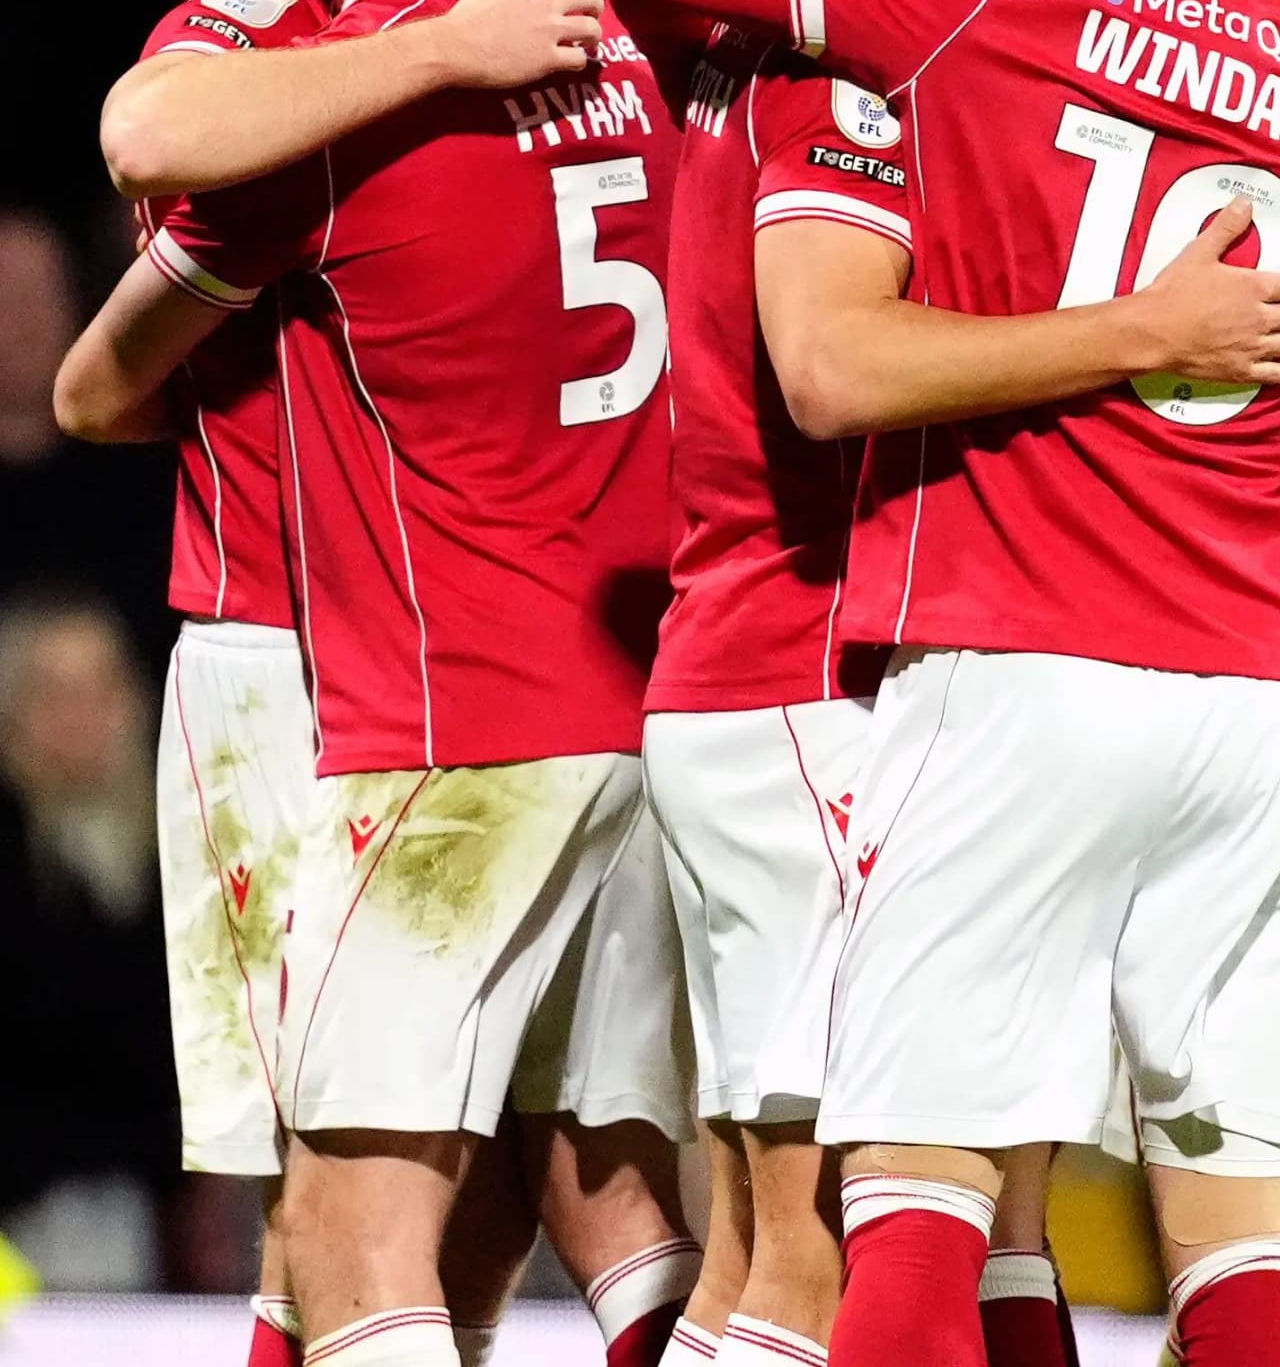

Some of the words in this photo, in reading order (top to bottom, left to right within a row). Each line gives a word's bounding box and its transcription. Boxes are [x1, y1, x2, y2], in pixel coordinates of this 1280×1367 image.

[503, 80, 653, 152] HYAM
[858, 122, 882, 137] EFL
[551, 156, 668, 427] 5
[1170, 403, 1185, 416] EFL
